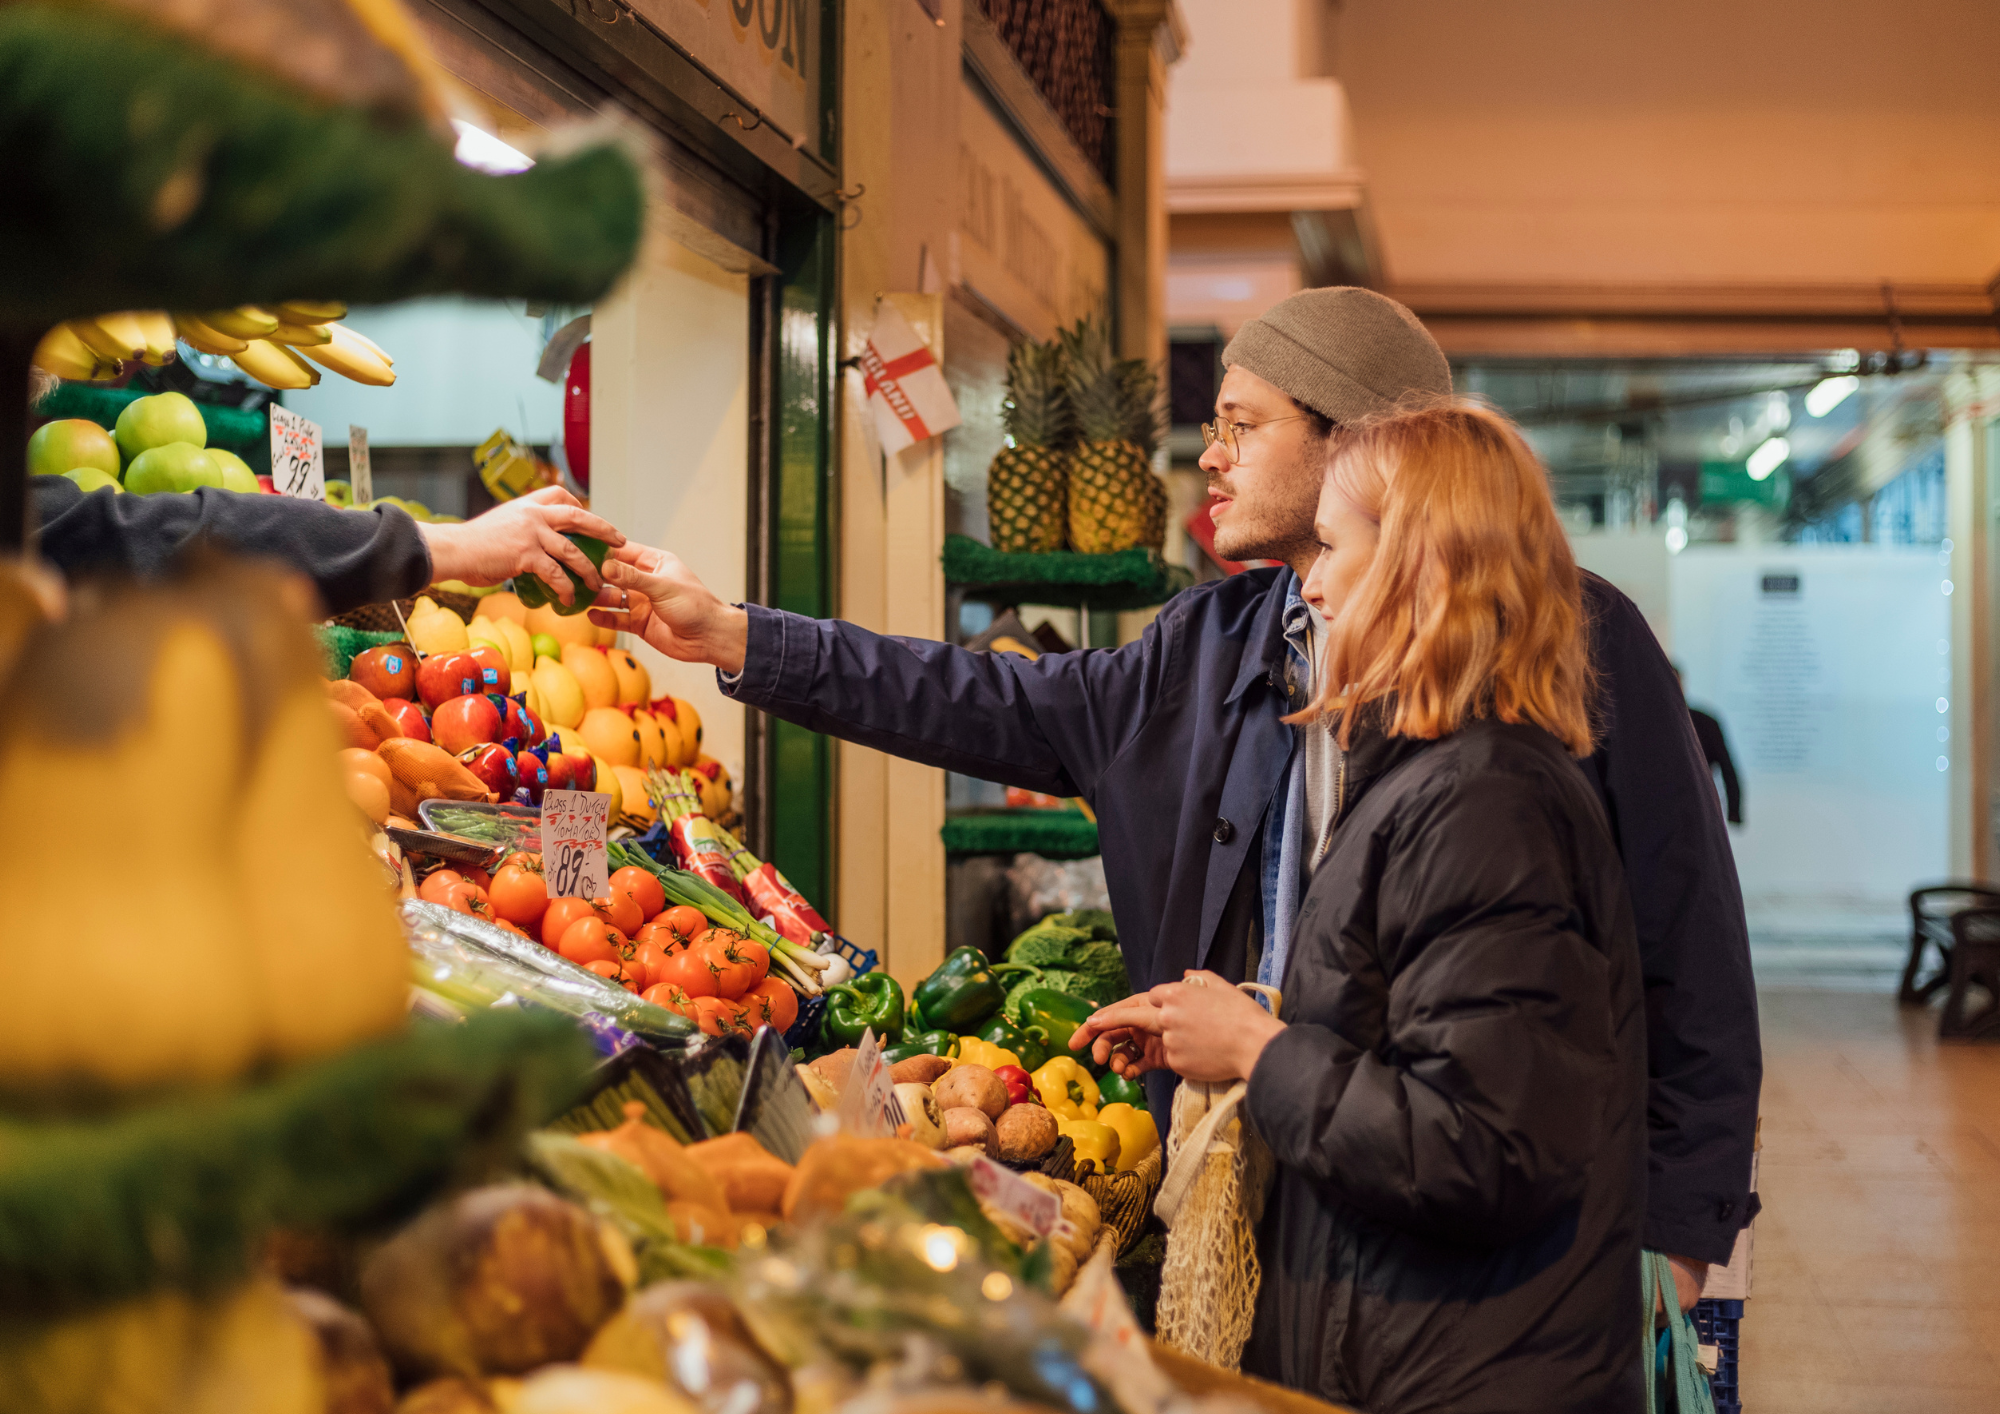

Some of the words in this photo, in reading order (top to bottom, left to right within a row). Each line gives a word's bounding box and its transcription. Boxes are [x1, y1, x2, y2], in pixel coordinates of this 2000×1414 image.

[544, 791, 567, 813] CLASS
[569, 793, 577, 812] 1
[580, 792, 608, 816] DUTCH
[554, 813, 601, 840] TOMATOES
